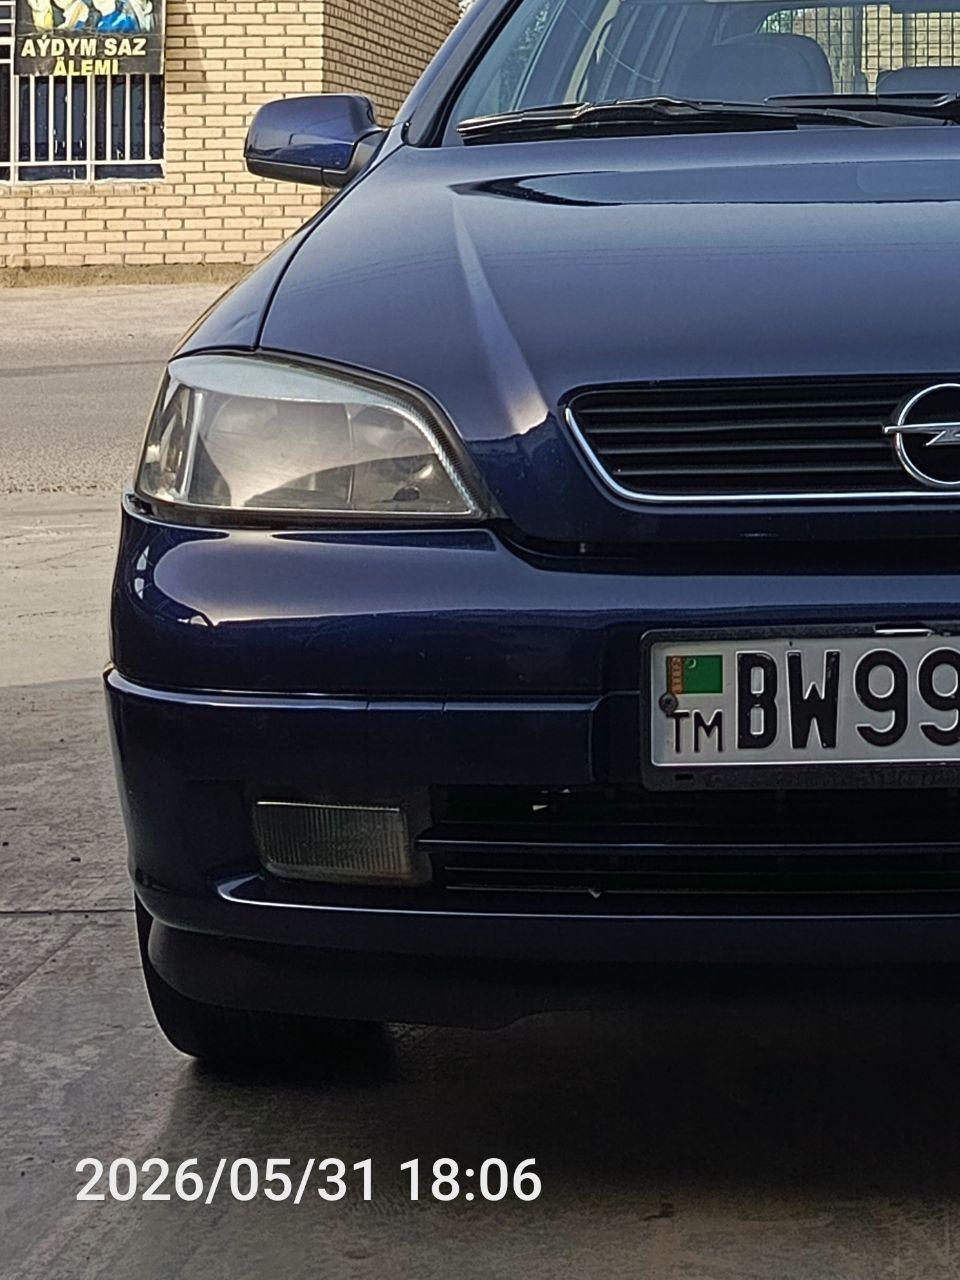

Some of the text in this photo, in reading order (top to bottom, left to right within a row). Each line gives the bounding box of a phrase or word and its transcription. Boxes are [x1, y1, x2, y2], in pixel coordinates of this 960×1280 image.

[21, 34, 147, 57] AÝDYM SAZ
[52, 56, 119, 76] ÄLEMI
[666, 709, 724, 754] TM
